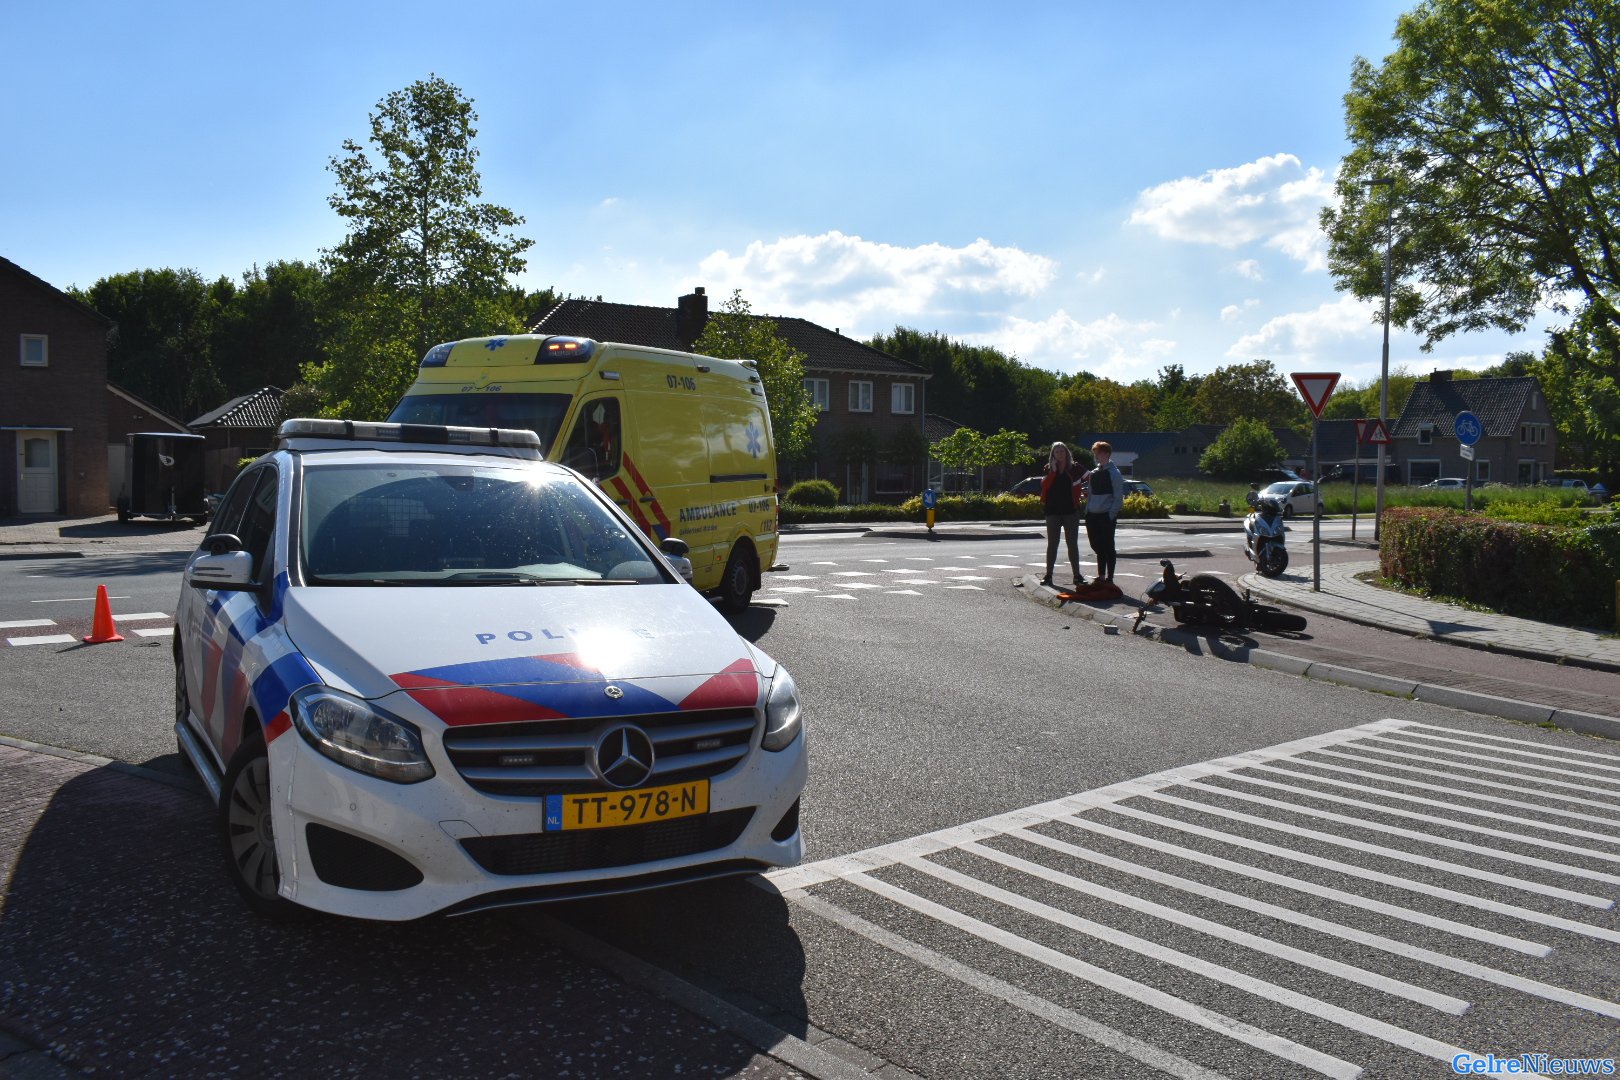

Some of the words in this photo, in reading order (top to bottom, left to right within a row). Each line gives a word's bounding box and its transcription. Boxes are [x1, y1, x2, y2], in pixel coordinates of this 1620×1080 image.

[666, 374, 696, 391] 07-106
[680, 503, 737, 522] AMBULANCE
[748, 499, 770, 513] 07-106
[475, 629, 656, 645] POLE
[572, 786, 696, 825] TT-978-N
[547, 816, 560, 825] NL
